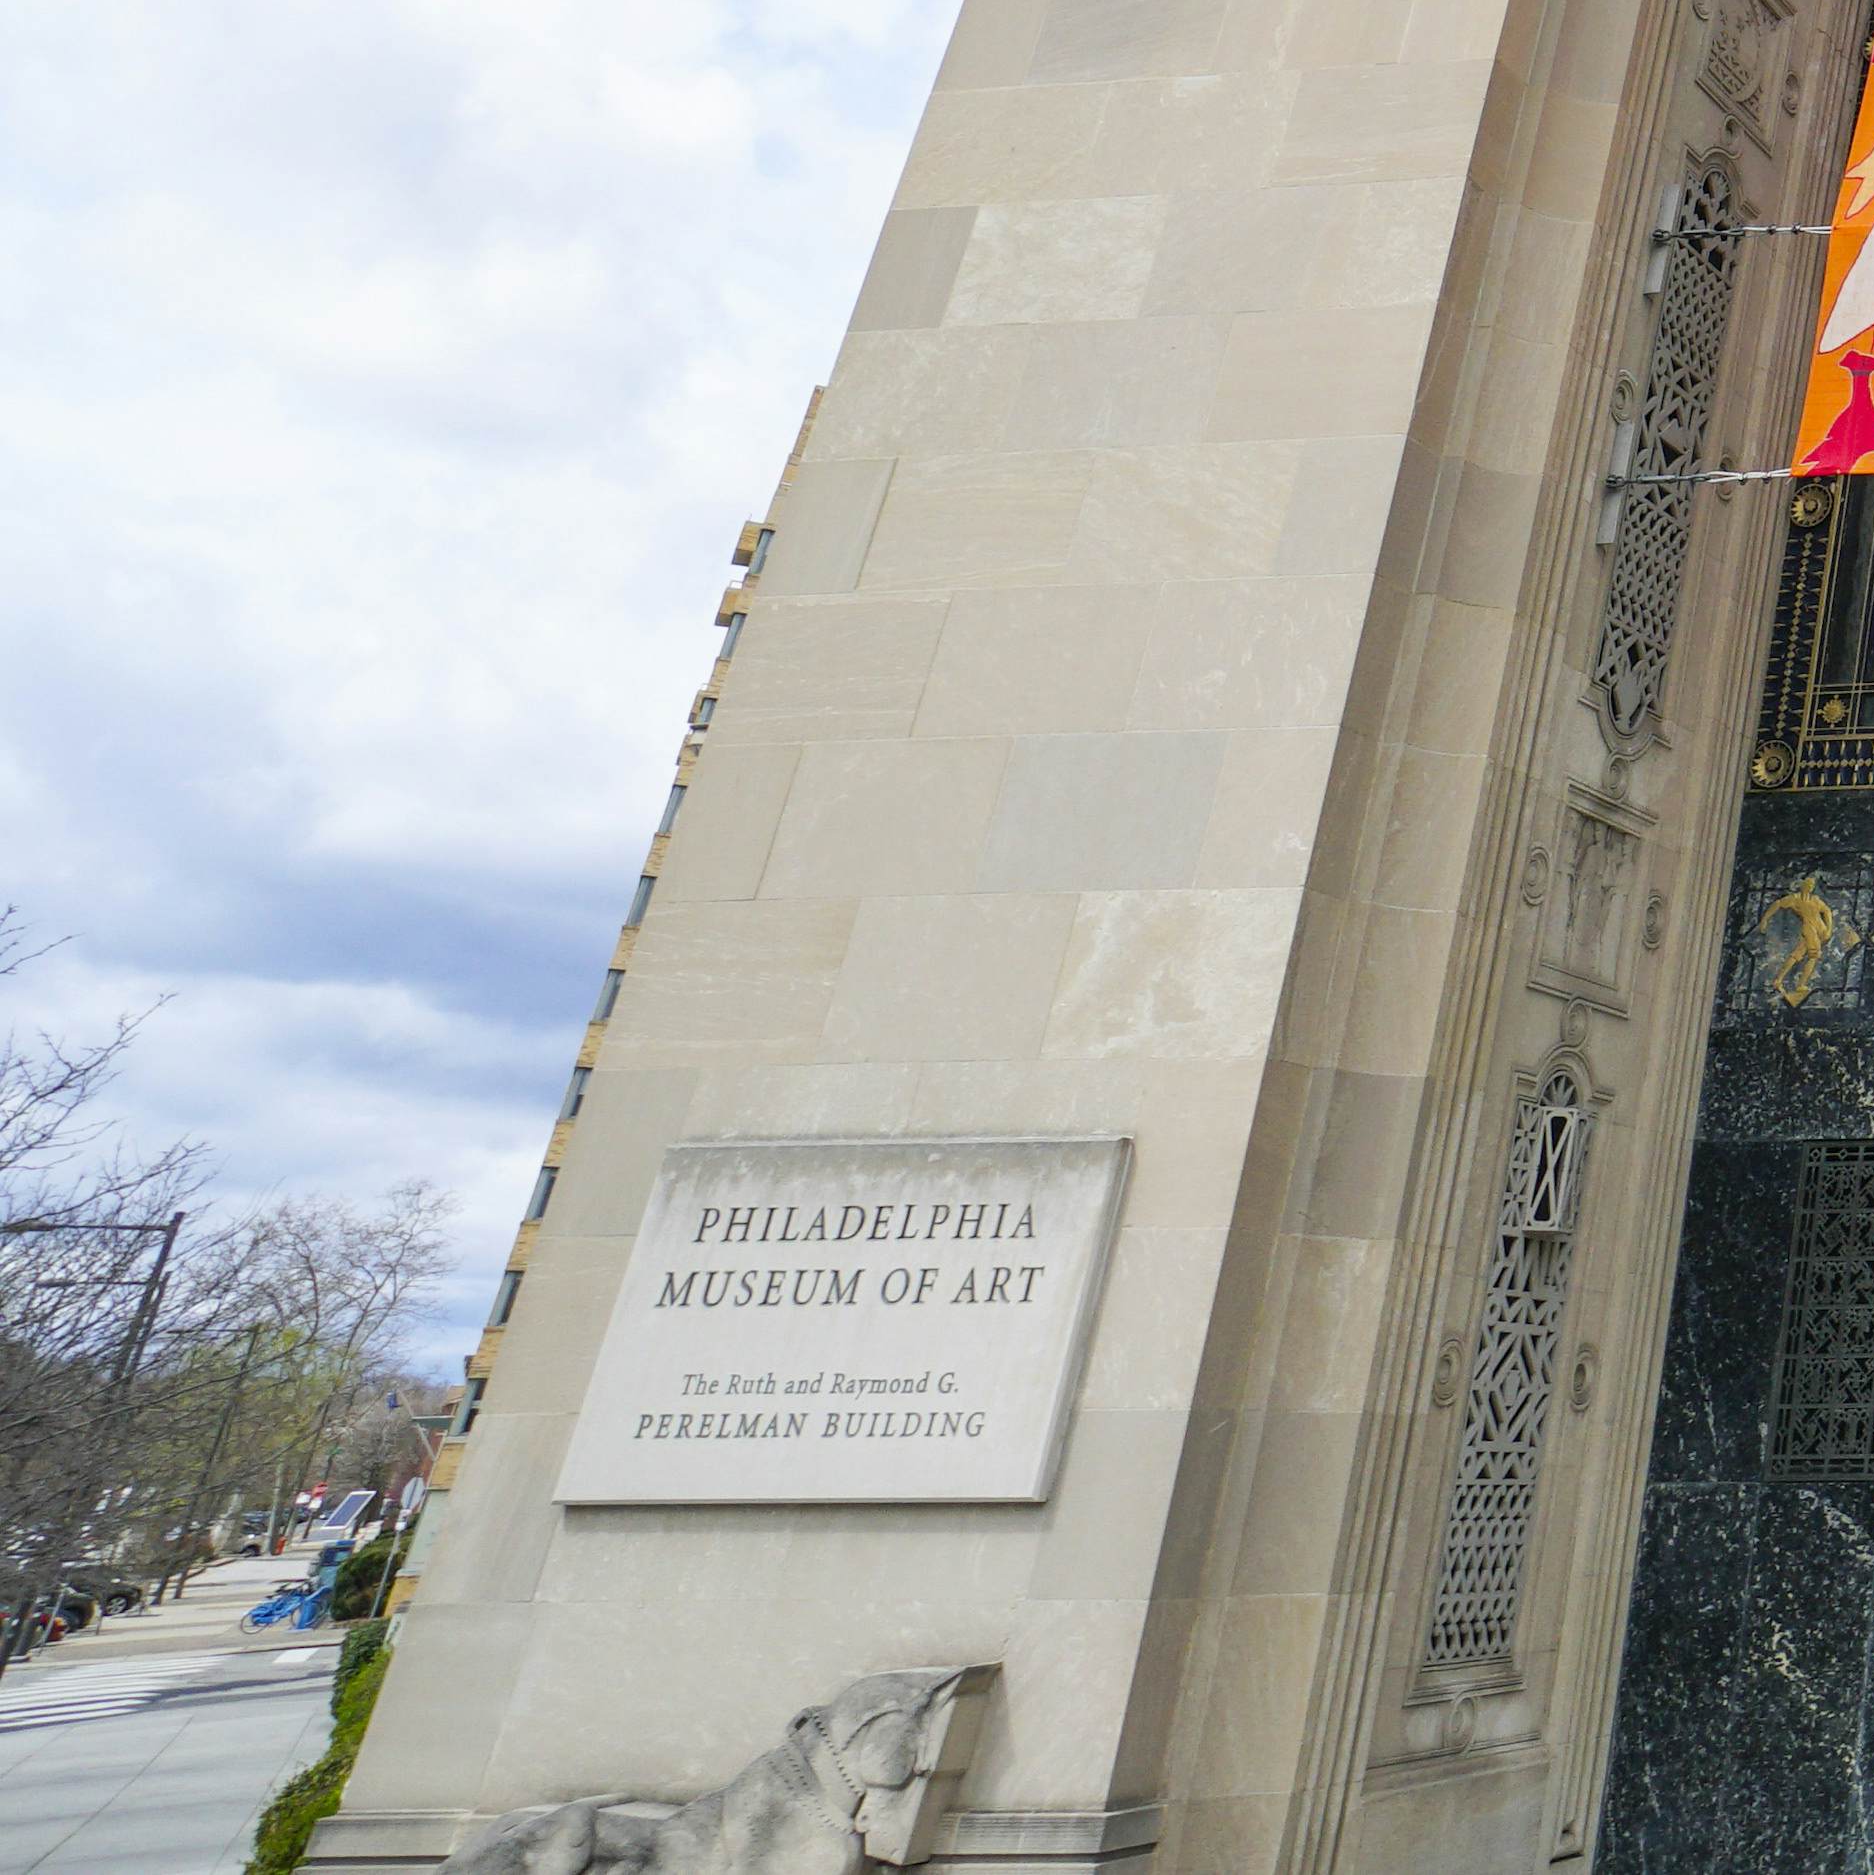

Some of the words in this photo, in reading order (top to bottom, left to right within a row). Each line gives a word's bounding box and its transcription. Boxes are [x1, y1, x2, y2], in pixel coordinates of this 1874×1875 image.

[692, 1203, 1038, 1243] PHILADELPHIA
[655, 1268, 865, 1308] MUSEUM
[880, 1267, 940, 1305] OF
[950, 1266, 1046, 1304] ART
[681, 1373, 720, 1397] The
[726, 1373, 777, 1396] Ruth
[784, 1372, 823, 1395] and
[830, 1372, 929, 1401] Raymond
[937, 1372, 959, 1394] G.
[633, 1412, 808, 1440] PERELMAN
[821, 1410, 986, 1439] BUILDING
